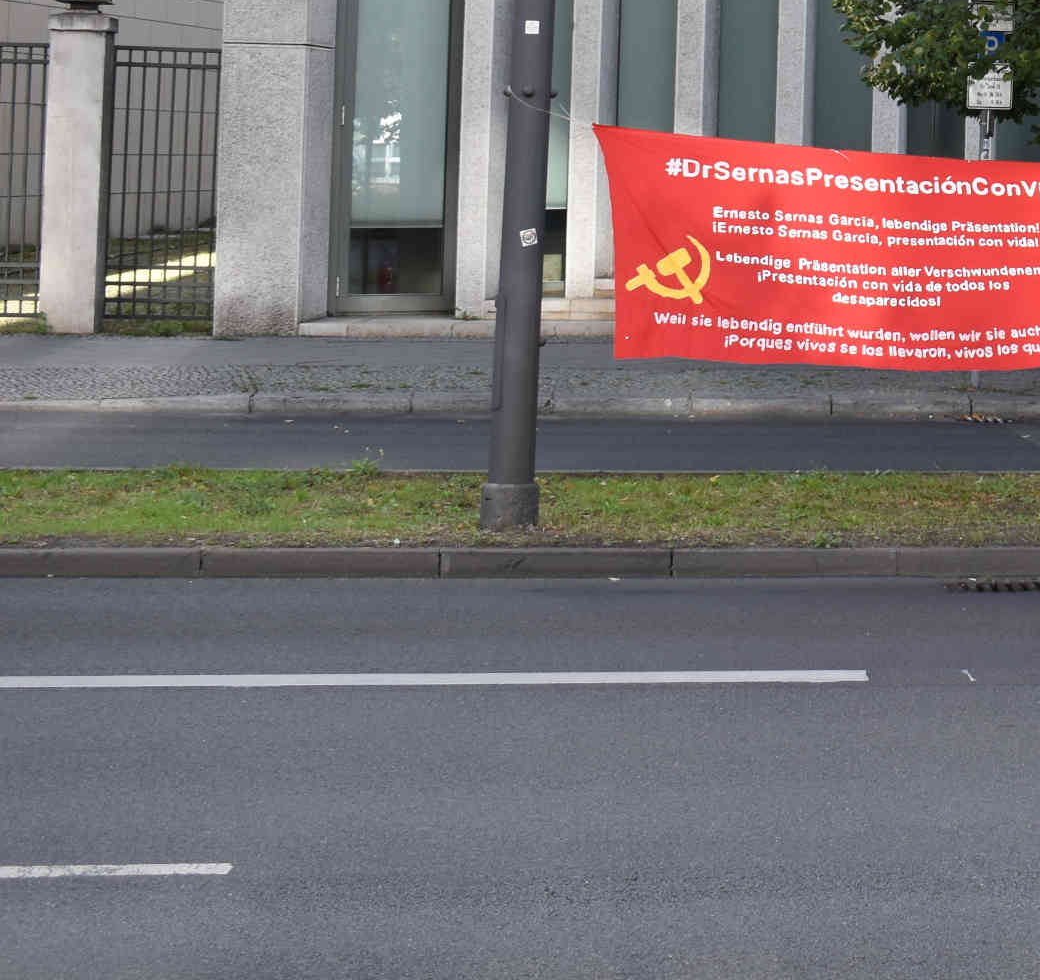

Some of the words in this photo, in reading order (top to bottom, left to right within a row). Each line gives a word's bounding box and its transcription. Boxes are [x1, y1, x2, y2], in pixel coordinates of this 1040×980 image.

[712, 206, 770, 221] Ernesto
[774, 209, 824, 225] Sernas
[882, 217, 948, 234] lebendige
[951, 220, 1040, 234] Präsentation!
[778, 224, 828, 240] Sernas
[887, 233, 976, 248] presentación
[978, 237, 1004, 247] con
[1007, 236, 1040, 248] vida!
[716, 251, 791, 269] Lebendige
[799, 258, 887, 276] Präsentation
[891, 265, 922, 277] aller
[758, 270, 857, 288] ¡Presentación
[862, 279, 889, 291] con
[892, 279, 923, 293] vida
[925, 280, 943, 292] de
[946, 279, 986, 293] todos
[988, 279, 1011, 291] los
[832, 292, 941, 307] desaparecidos!
[654, 311, 686, 325] Weil
[691, 313, 713, 327] sie
[717, 315, 783, 335] lebendig
[785, 321, 844, 338] entführt
[847, 327, 906, 343] wurden,
[909, 329, 956, 342] wollen
[958, 329, 982, 343] wir
[985, 326, 1006, 342] sie
[796, 338, 837, 354] vivos
[839, 343, 857, 355] se
[861, 343, 884, 357] los
[888, 345, 952, 360] llevaron,
[954, 346, 994, 360] vivos
[997, 344, 1018, 357] los
